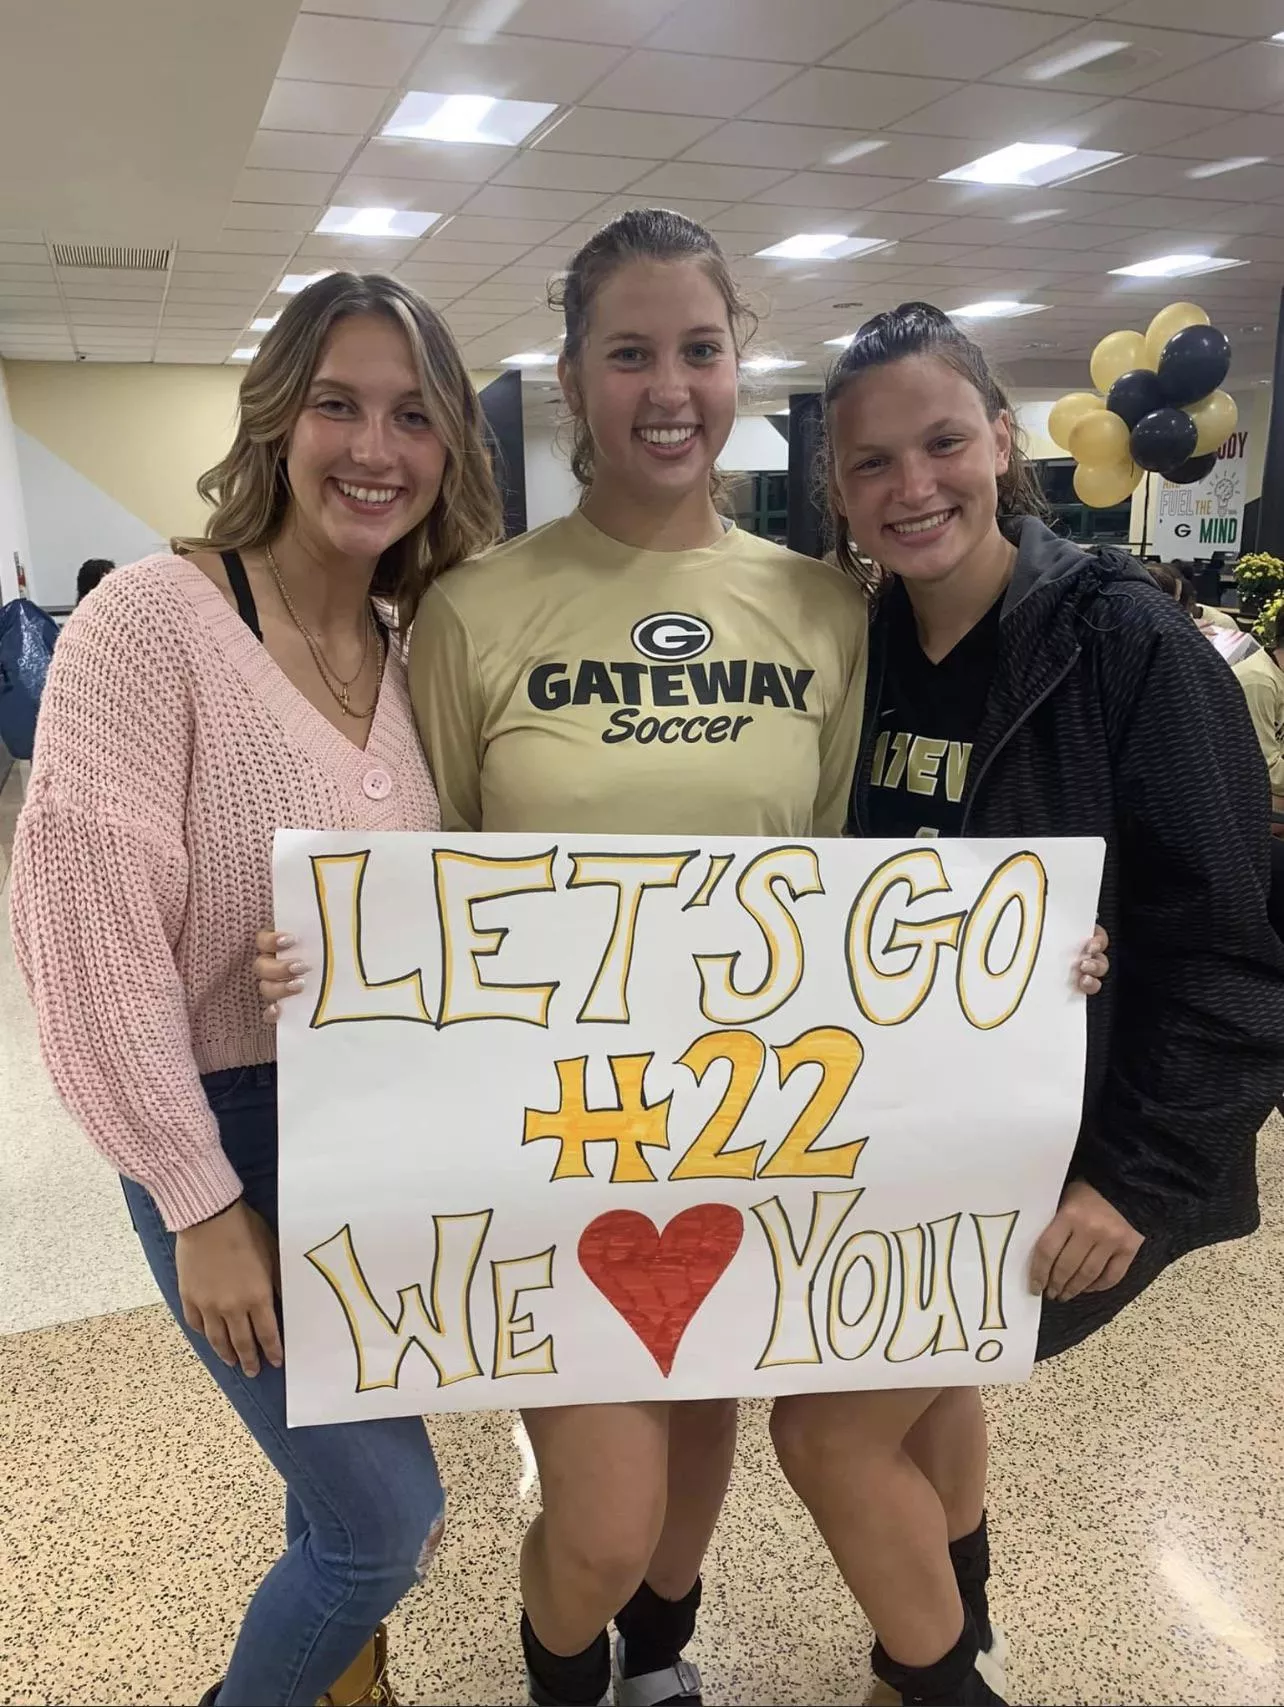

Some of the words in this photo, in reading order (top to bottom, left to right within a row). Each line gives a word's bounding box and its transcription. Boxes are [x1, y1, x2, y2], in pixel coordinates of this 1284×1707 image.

[1217, 432, 1248, 460] ODY
[1160, 490, 1194, 516] FUEL
[1195, 500, 1213, 515] THE
[1199, 518, 1238, 544] MIND
[638, 618, 706, 656] G
[527, 659, 816, 712] GATEWAY
[601, 708, 754, 744] Soccer
[309, 845, 826, 1031] LET'S
[845, 848, 1049, 1030] GO
[521, 1026, 870, 1183] #22
[304, 1209, 559, 1393] WE
